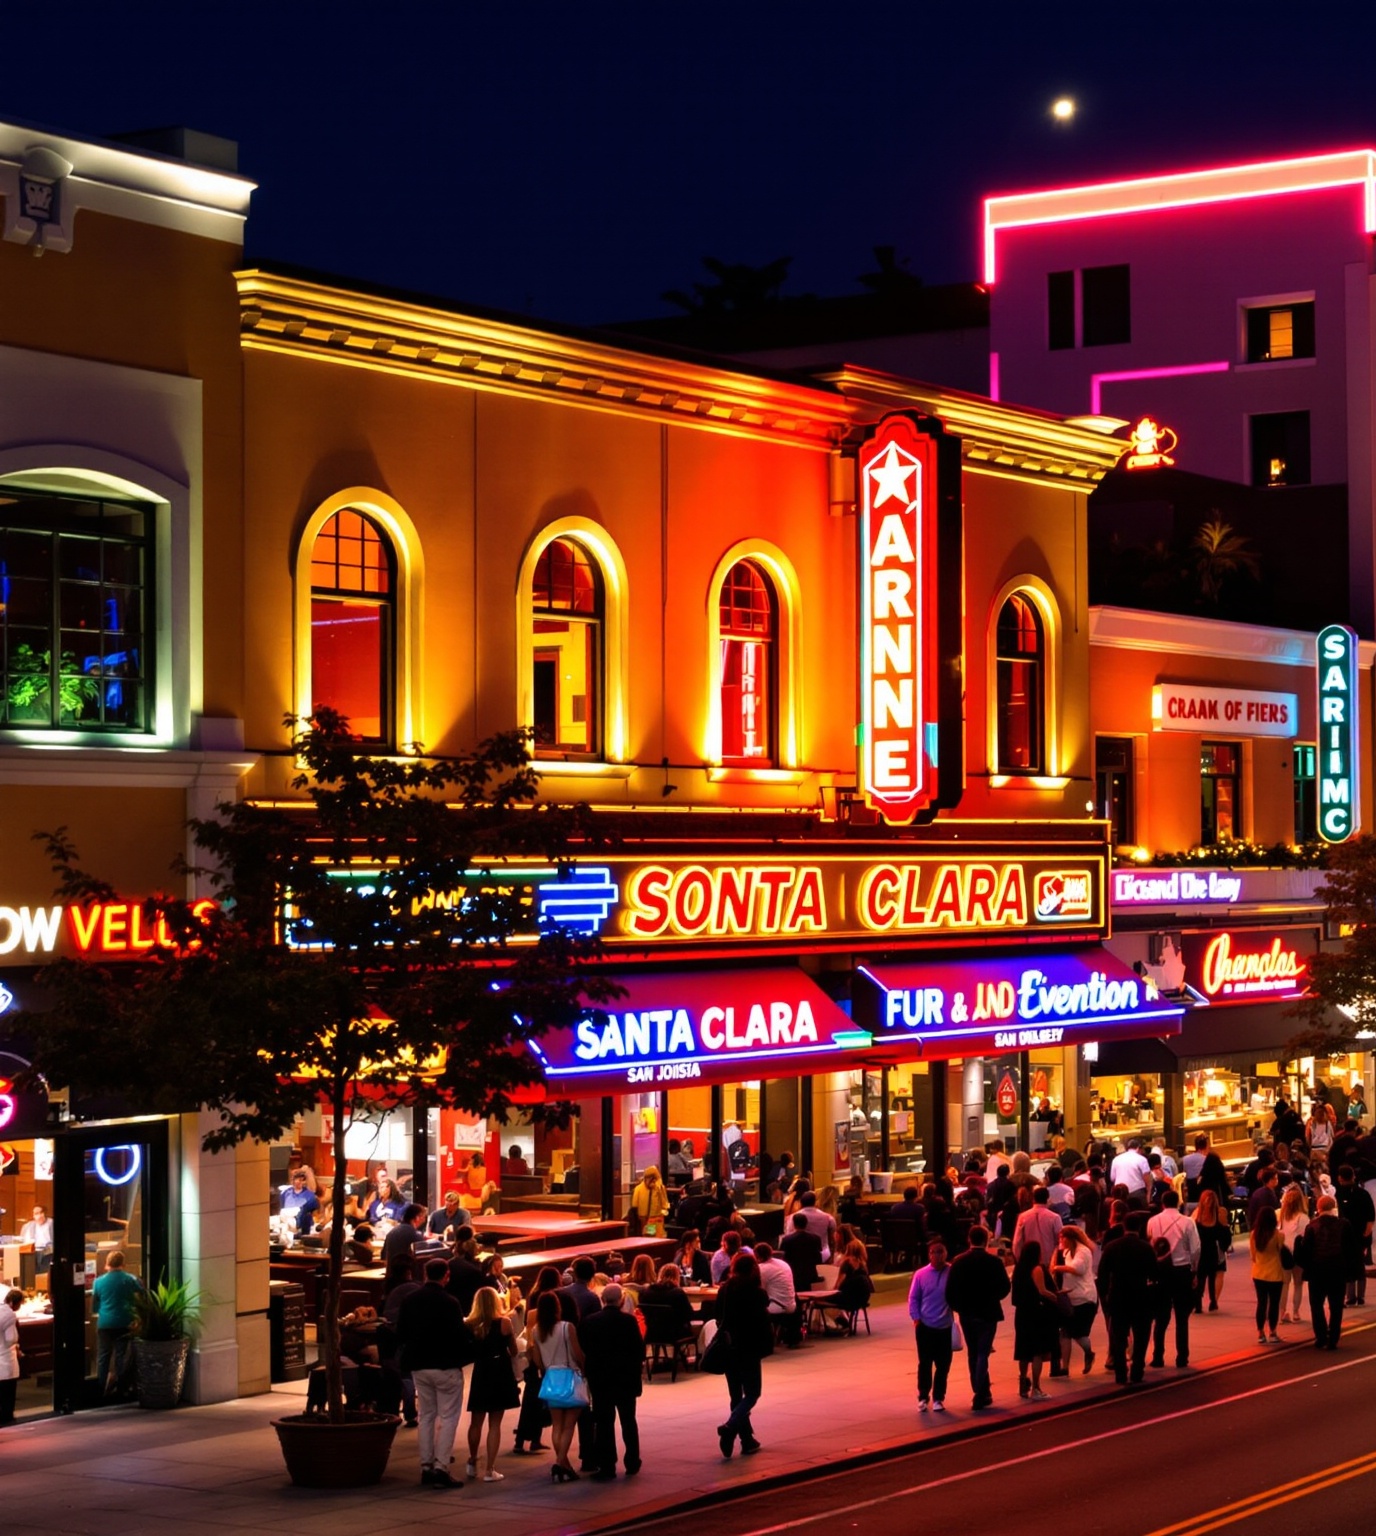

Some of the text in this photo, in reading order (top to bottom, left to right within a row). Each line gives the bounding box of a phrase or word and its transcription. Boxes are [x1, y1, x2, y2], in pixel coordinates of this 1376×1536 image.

[870, 514, 915, 787] ARNNE
[1224, 700, 1242, 721] OF
[1247, 701, 1289, 724] FIERS
[622, 865, 828, 937] SONTA
[858, 863, 1028, 931] CLARA
[575, 1000, 818, 1060] SANTA CLARA
[886, 987, 944, 1027] FUR
[951, 992, 969, 1023] &
[627, 1067, 653, 1083] SAN
